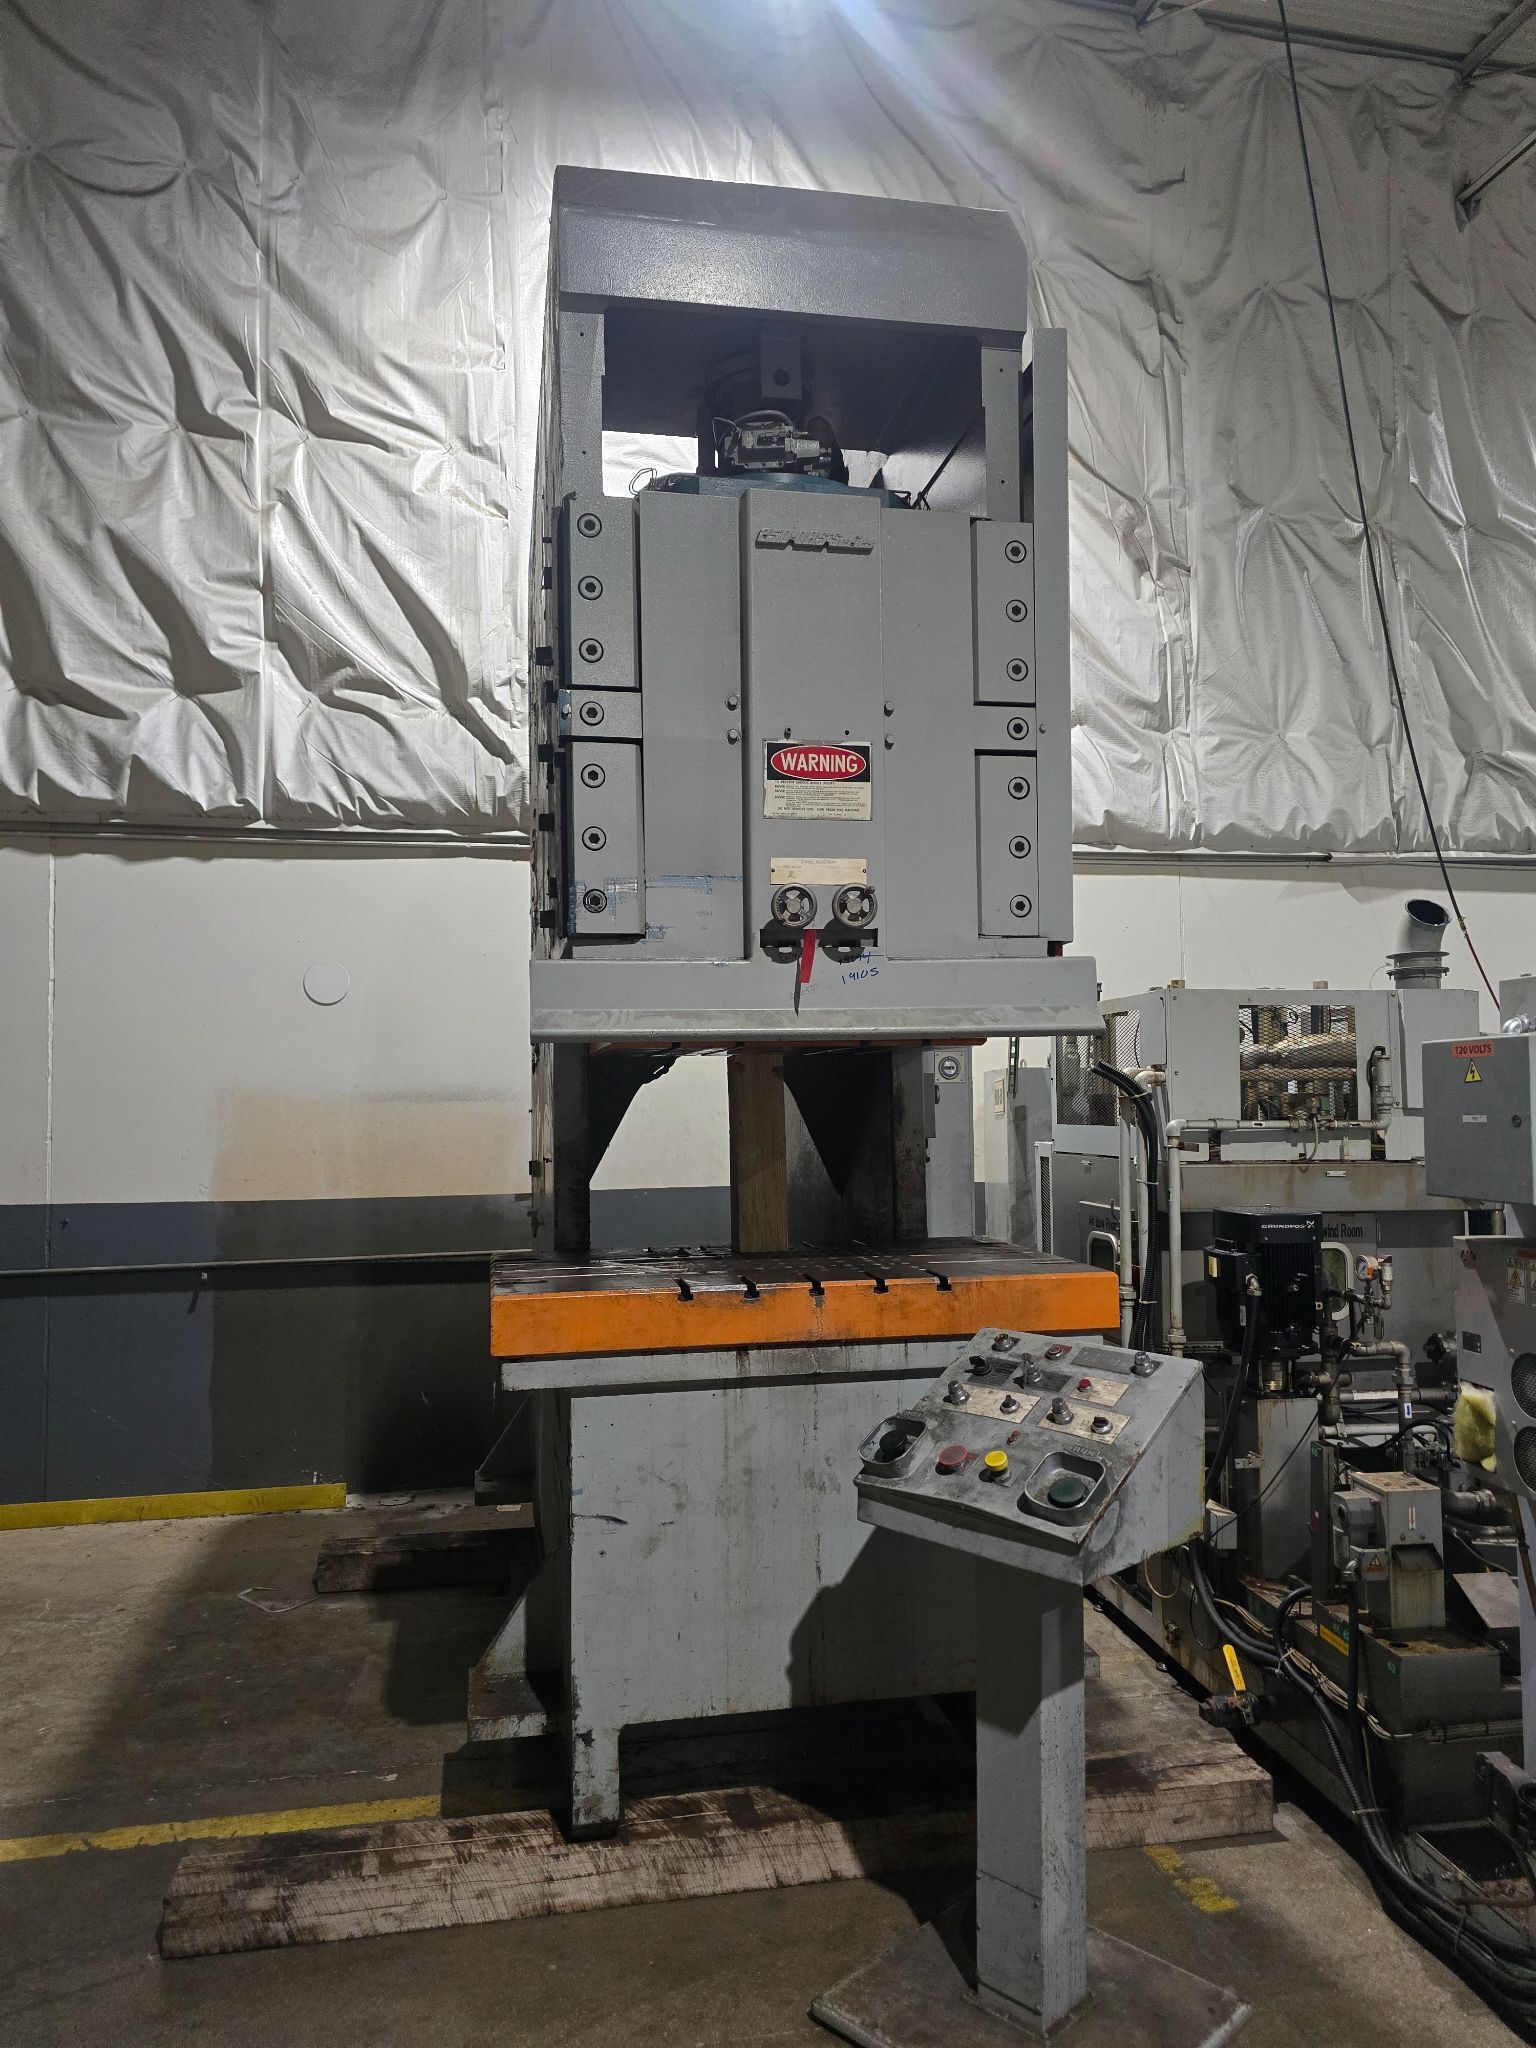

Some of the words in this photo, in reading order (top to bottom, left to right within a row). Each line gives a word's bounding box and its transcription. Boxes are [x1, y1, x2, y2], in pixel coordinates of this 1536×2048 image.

[781, 752, 858, 773] WARNING
[1454, 1046, 1468, 1055] 120
[1468, 1044, 1492, 1054] VOLTS
[1341, 1223, 1364, 1238] Room
